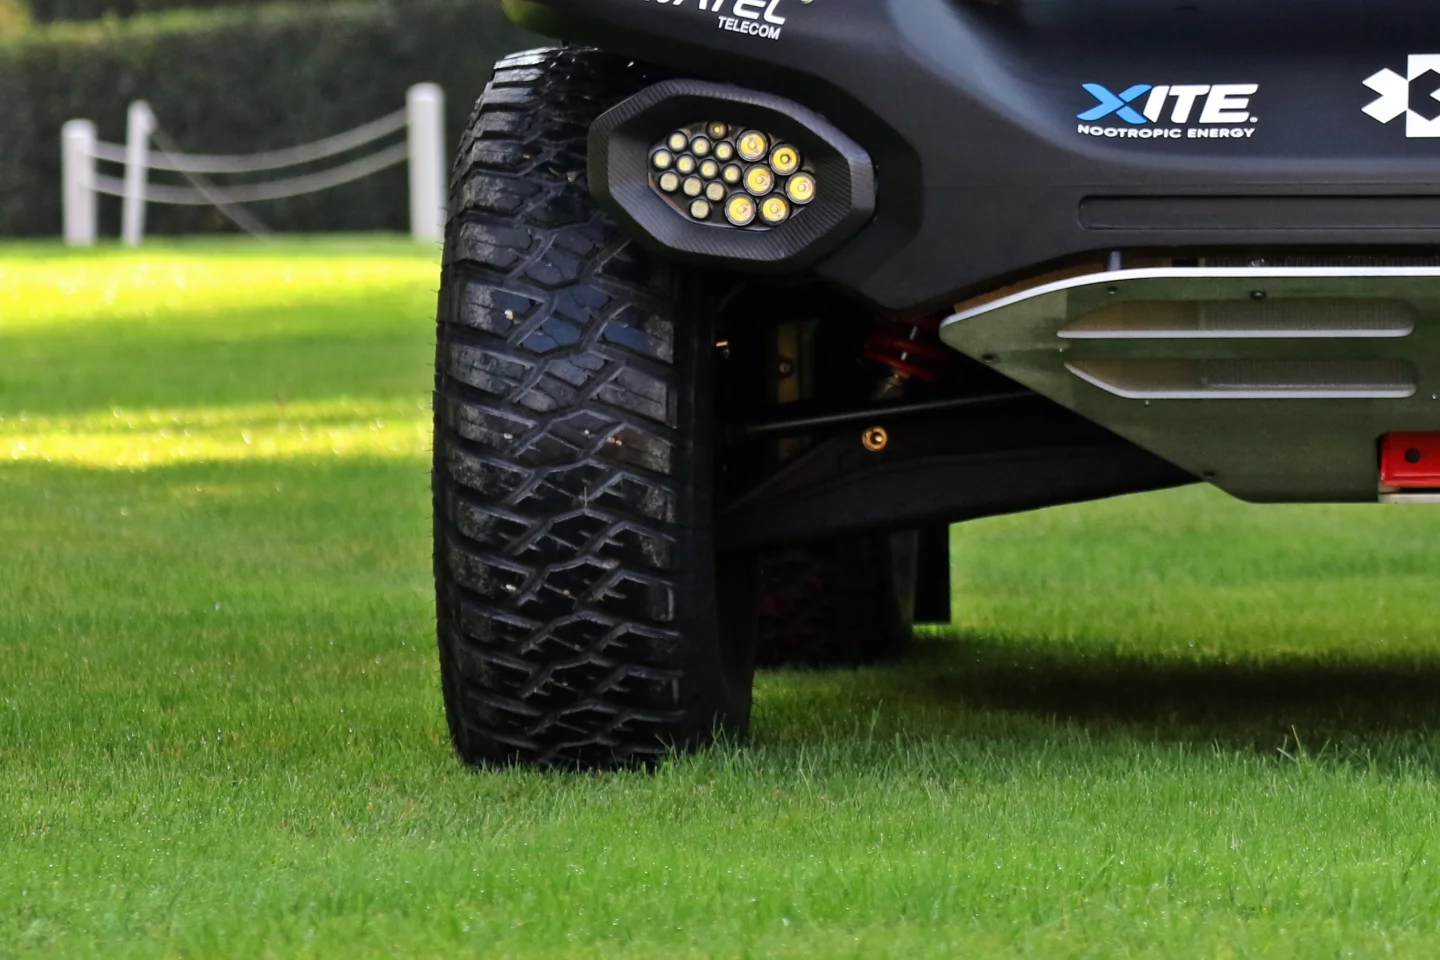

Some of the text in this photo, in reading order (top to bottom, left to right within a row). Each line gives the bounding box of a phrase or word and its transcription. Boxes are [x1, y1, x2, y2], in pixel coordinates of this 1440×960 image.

[718, 16, 781, 40] TELECOM
[1077, 124, 1256, 139] NOOTROPIC ENERGY
